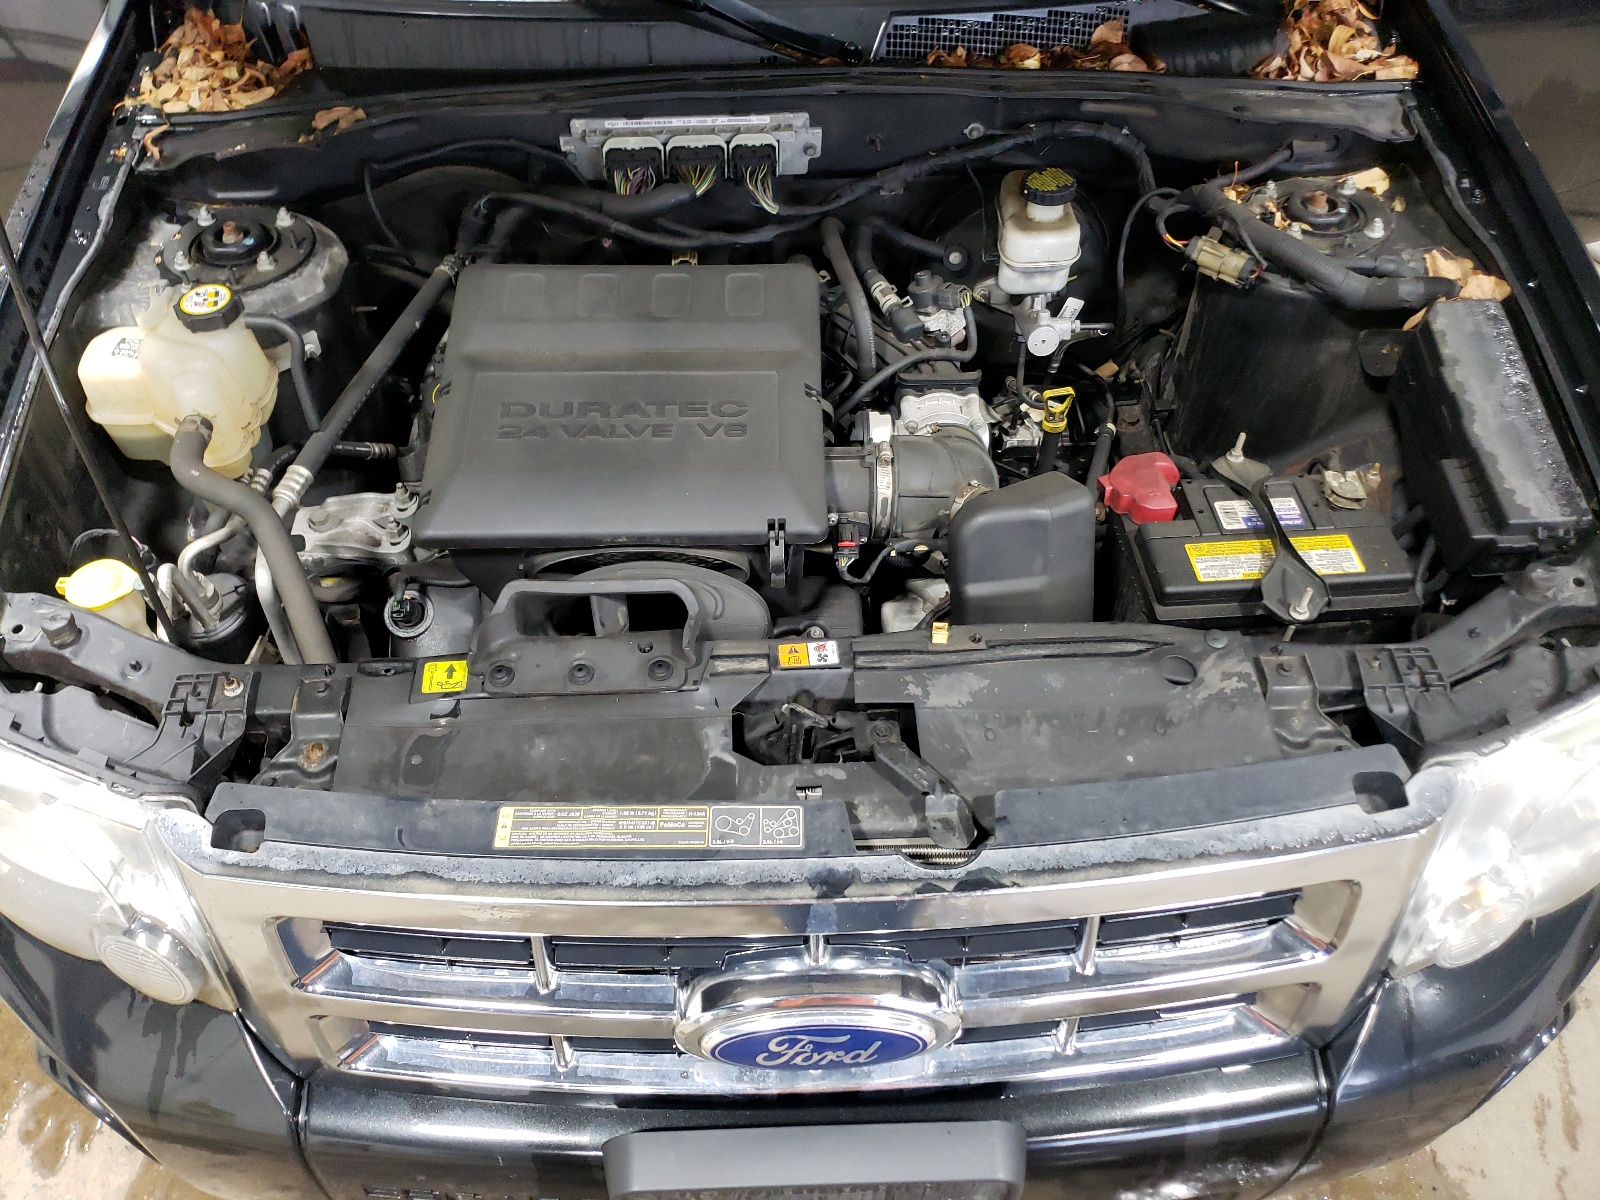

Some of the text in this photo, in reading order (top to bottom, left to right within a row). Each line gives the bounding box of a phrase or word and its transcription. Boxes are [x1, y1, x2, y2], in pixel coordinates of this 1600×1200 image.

[500, 400, 748, 419] DURATEC
[497, 422, 748, 439] 24 VALVE V6
[755, 1034, 882, 1067] Ford
